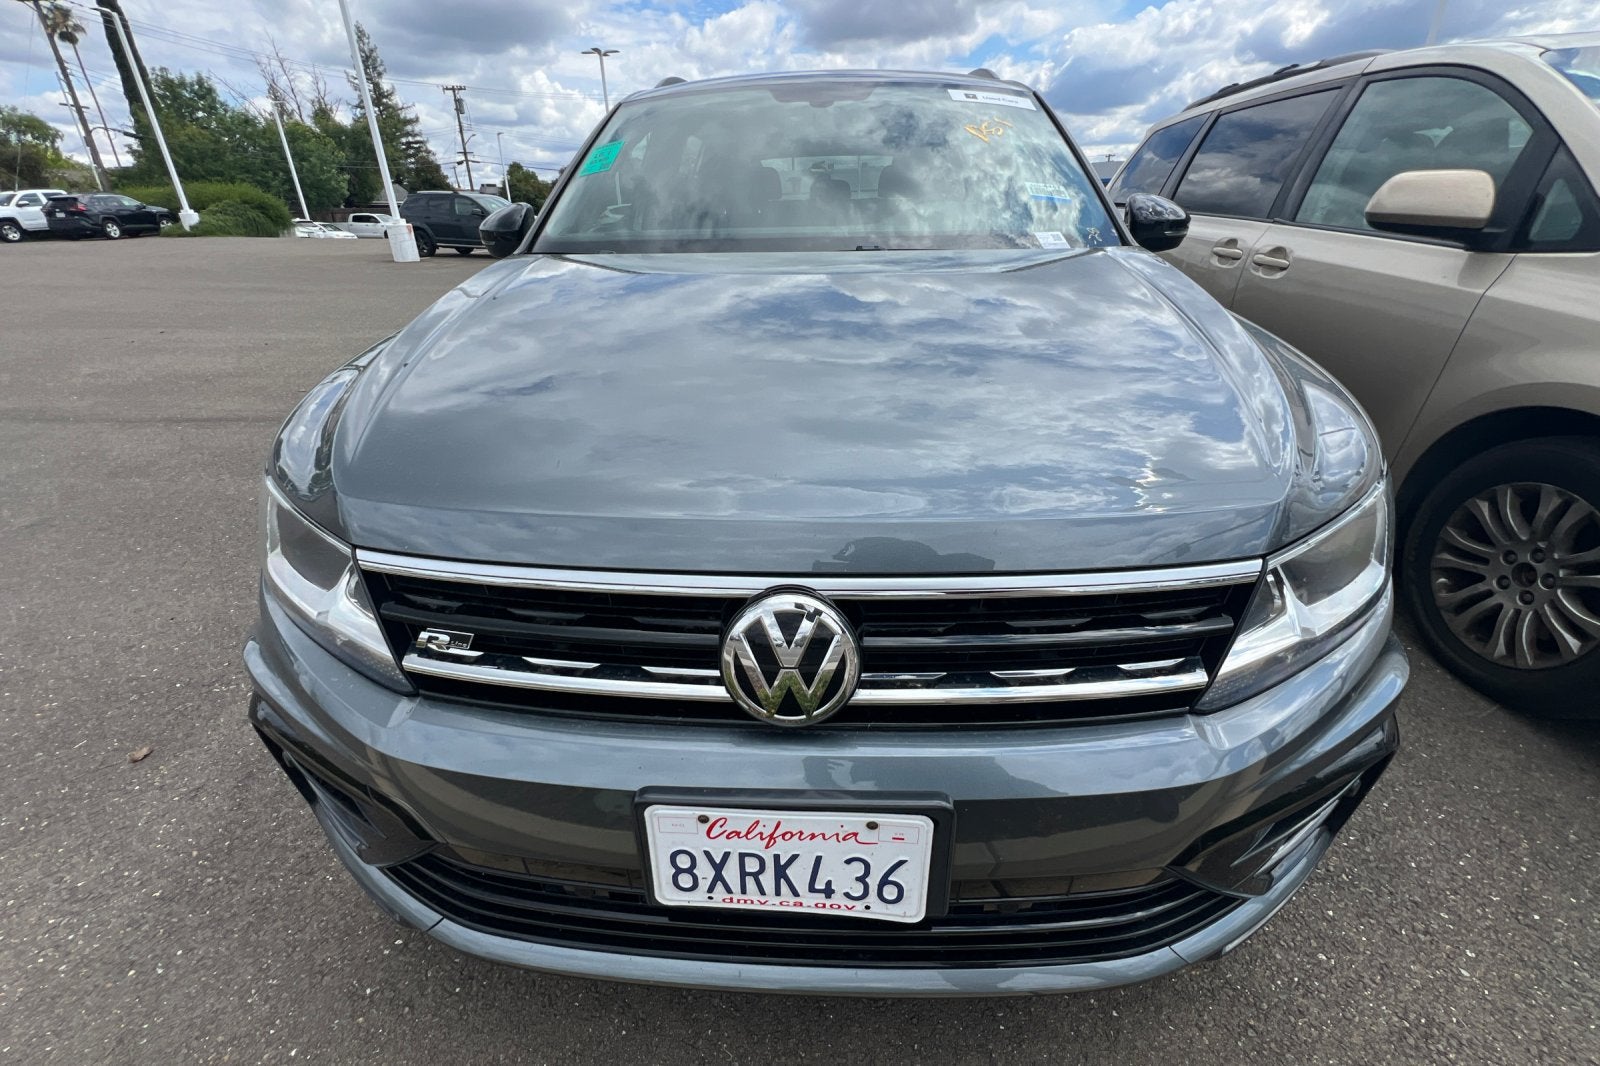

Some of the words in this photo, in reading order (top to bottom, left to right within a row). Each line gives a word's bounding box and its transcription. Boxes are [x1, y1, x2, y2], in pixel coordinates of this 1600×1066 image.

[705, 816, 879, 850] California
[669, 849, 909, 905] 8XRK436
[721, 896, 857, 911] dmv.ca.gov
